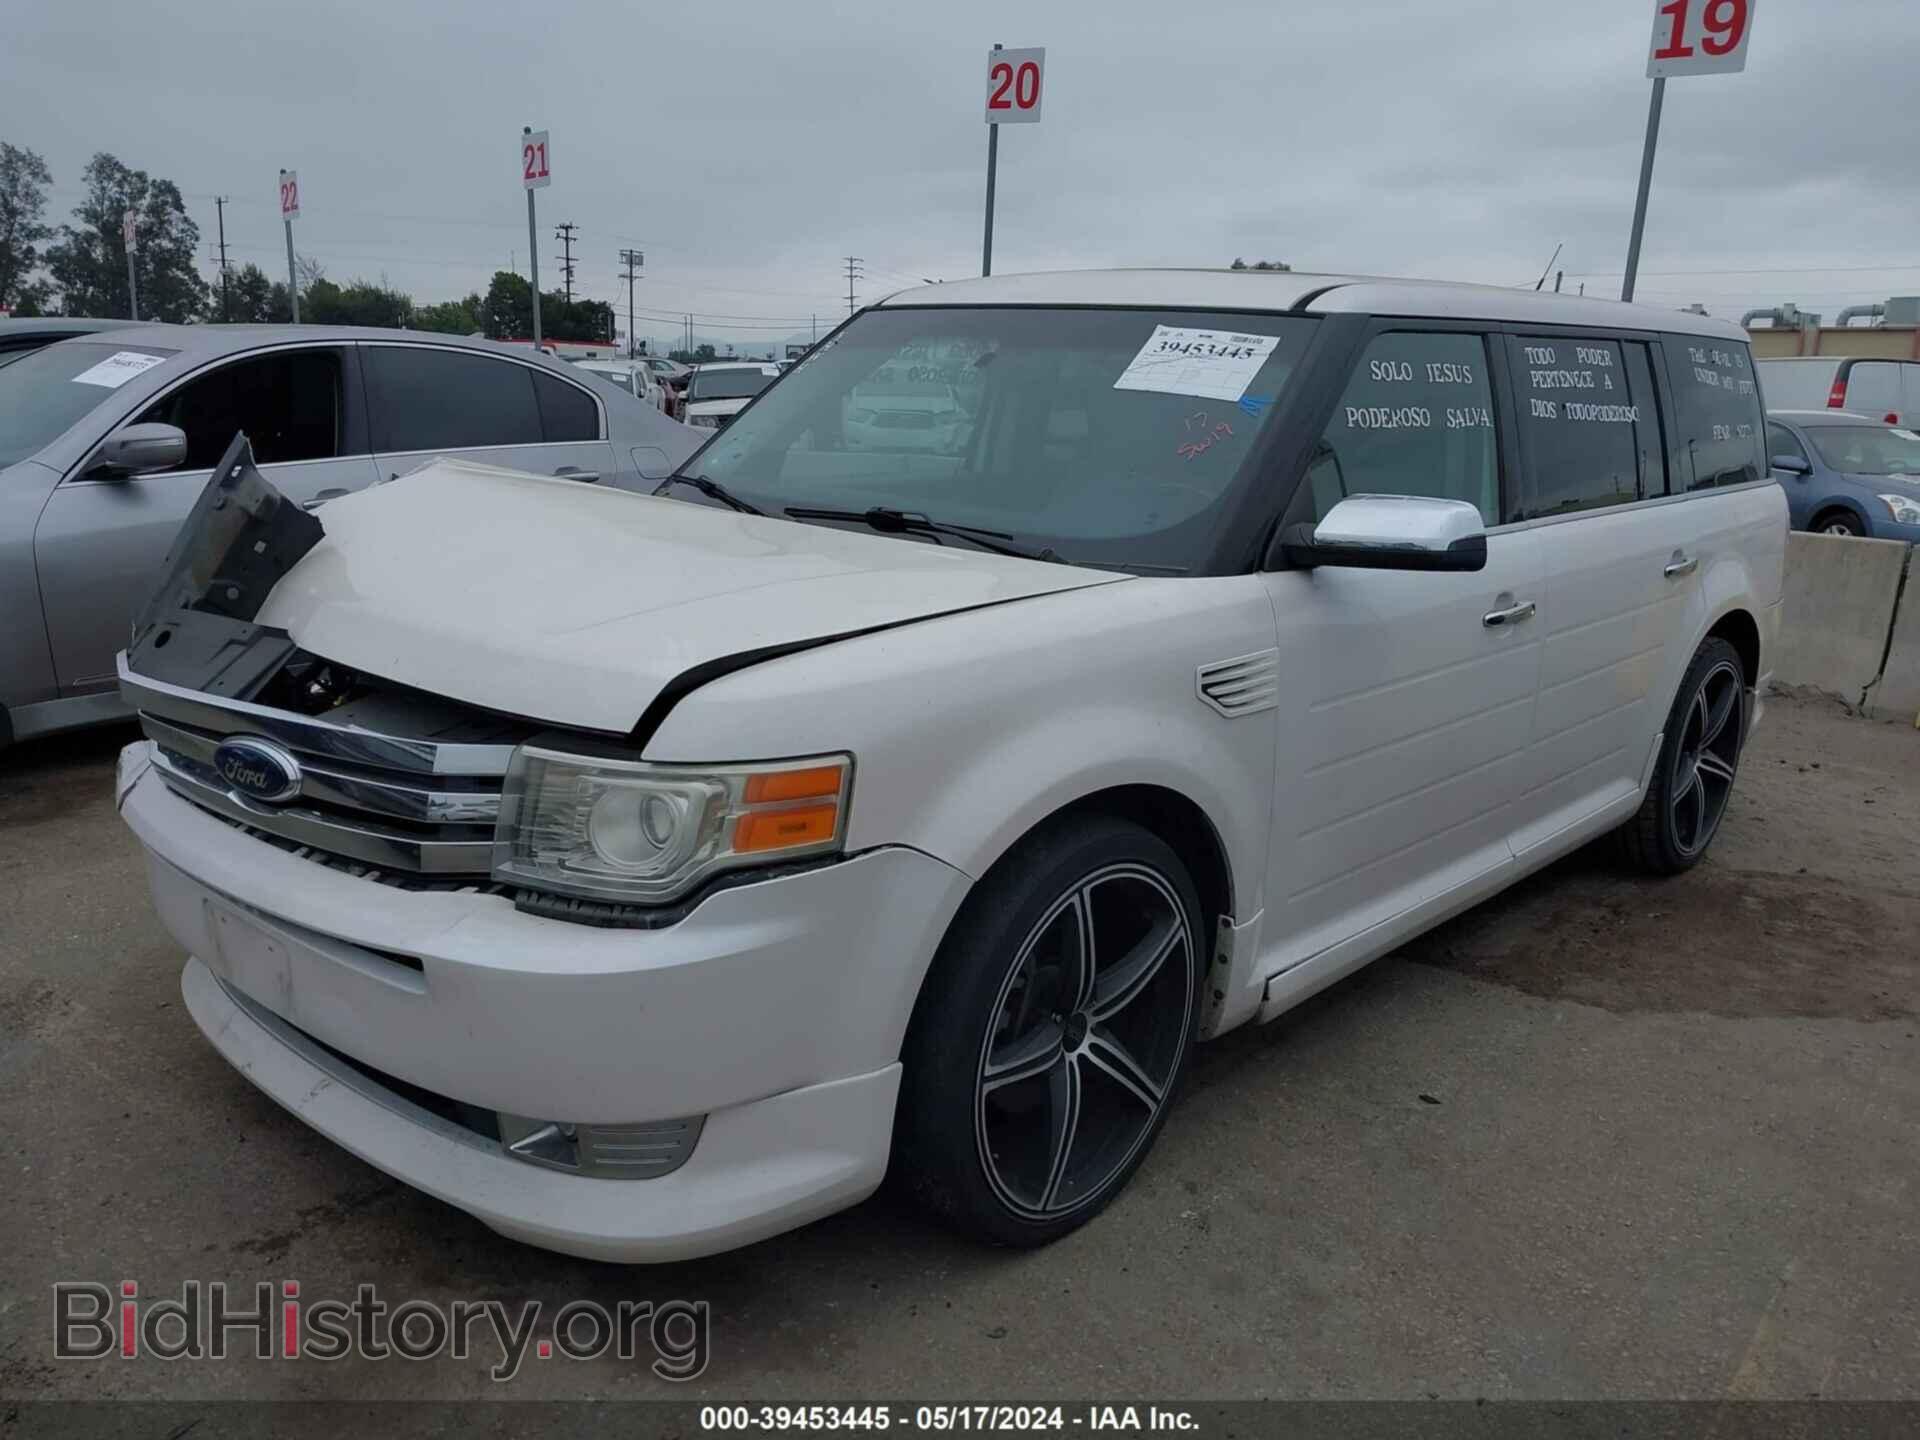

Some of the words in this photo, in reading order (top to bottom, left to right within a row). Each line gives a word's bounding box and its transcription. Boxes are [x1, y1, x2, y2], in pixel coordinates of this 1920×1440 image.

[1654, 0, 1747, 59] 19
[989, 62, 1040, 109] 20
[523, 143, 549, 179] 21
[281, 181, 298, 212] 22
[1524, 347, 1556, 365] TODO
[1576, 347, 1613, 366] PODER
[1370, 360, 1413, 381] SOLO
[1604, 374, 1613, 390] A
[1345, 406, 1431, 429] PODEROSO
[1446, 407, 1492, 429] SALVA
[1530, 399, 1557, 419] DIOS
[225, 758, 269, 789] Ford
